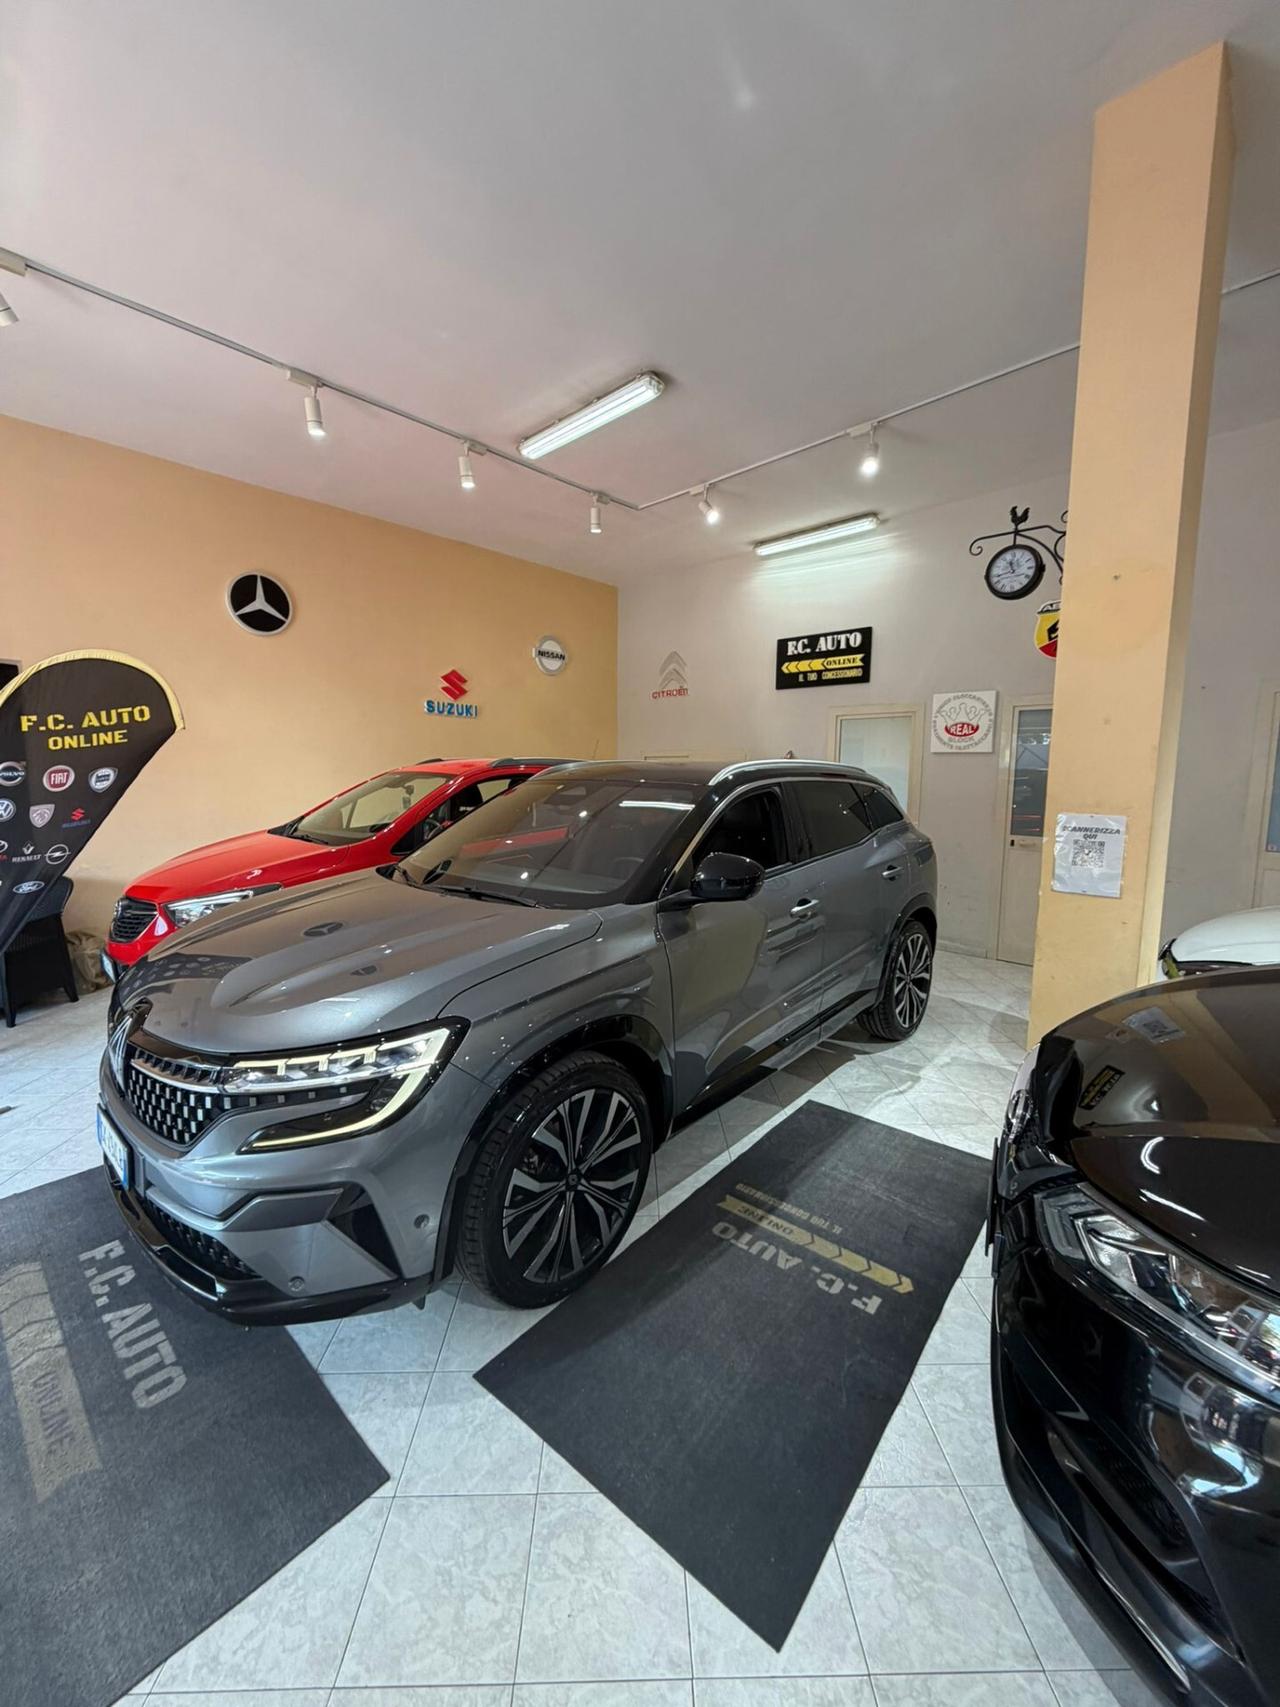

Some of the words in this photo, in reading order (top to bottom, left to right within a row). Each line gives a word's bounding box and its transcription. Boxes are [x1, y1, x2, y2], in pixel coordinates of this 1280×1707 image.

[816, 632, 862, 652] AUTO
[538, 650, 565, 660] NISSAN
[826, 657, 858, 666] ONLINE
[20, 714, 74, 732] F.C.
[82, 705, 151, 729] AUTO
[424, 700, 478, 718] SUZUKI
[48, 729, 128, 750] ONLINE
[949, 723, 976, 736] REAL
[51, 772, 69, 785] FIAT
[737, 1206, 794, 1236] ONLINE
[712, 1221, 803, 1271] AUTO
[79, 1239, 136, 1308] F.C.
[811, 1265, 883, 1316] F.C.
[101, 1302, 188, 1409] AUTO
